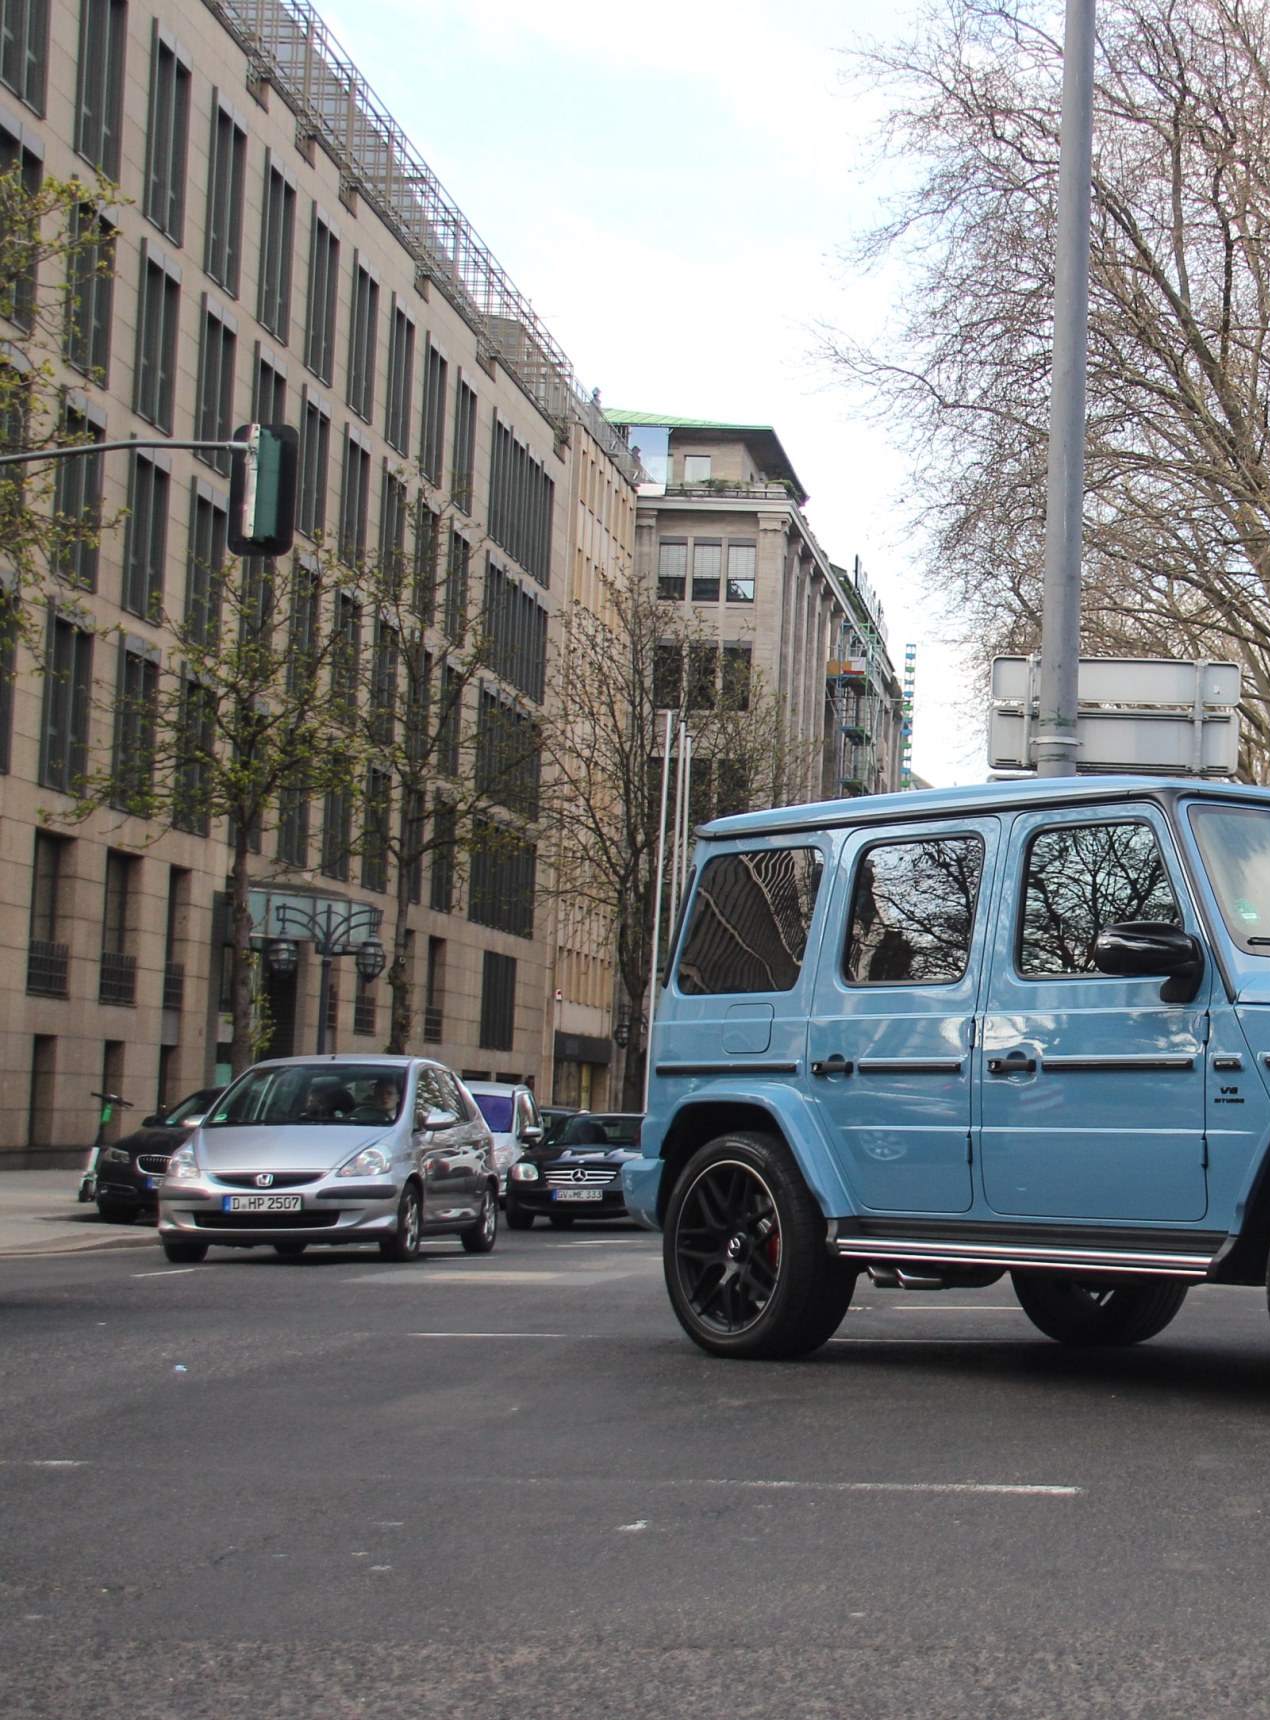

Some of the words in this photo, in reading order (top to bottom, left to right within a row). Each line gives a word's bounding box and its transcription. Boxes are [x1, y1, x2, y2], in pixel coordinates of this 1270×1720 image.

[232, 1197, 240, 1210] D
[248, 1197, 265, 1210] HP
[267, 1197, 300, 1210] 2507
